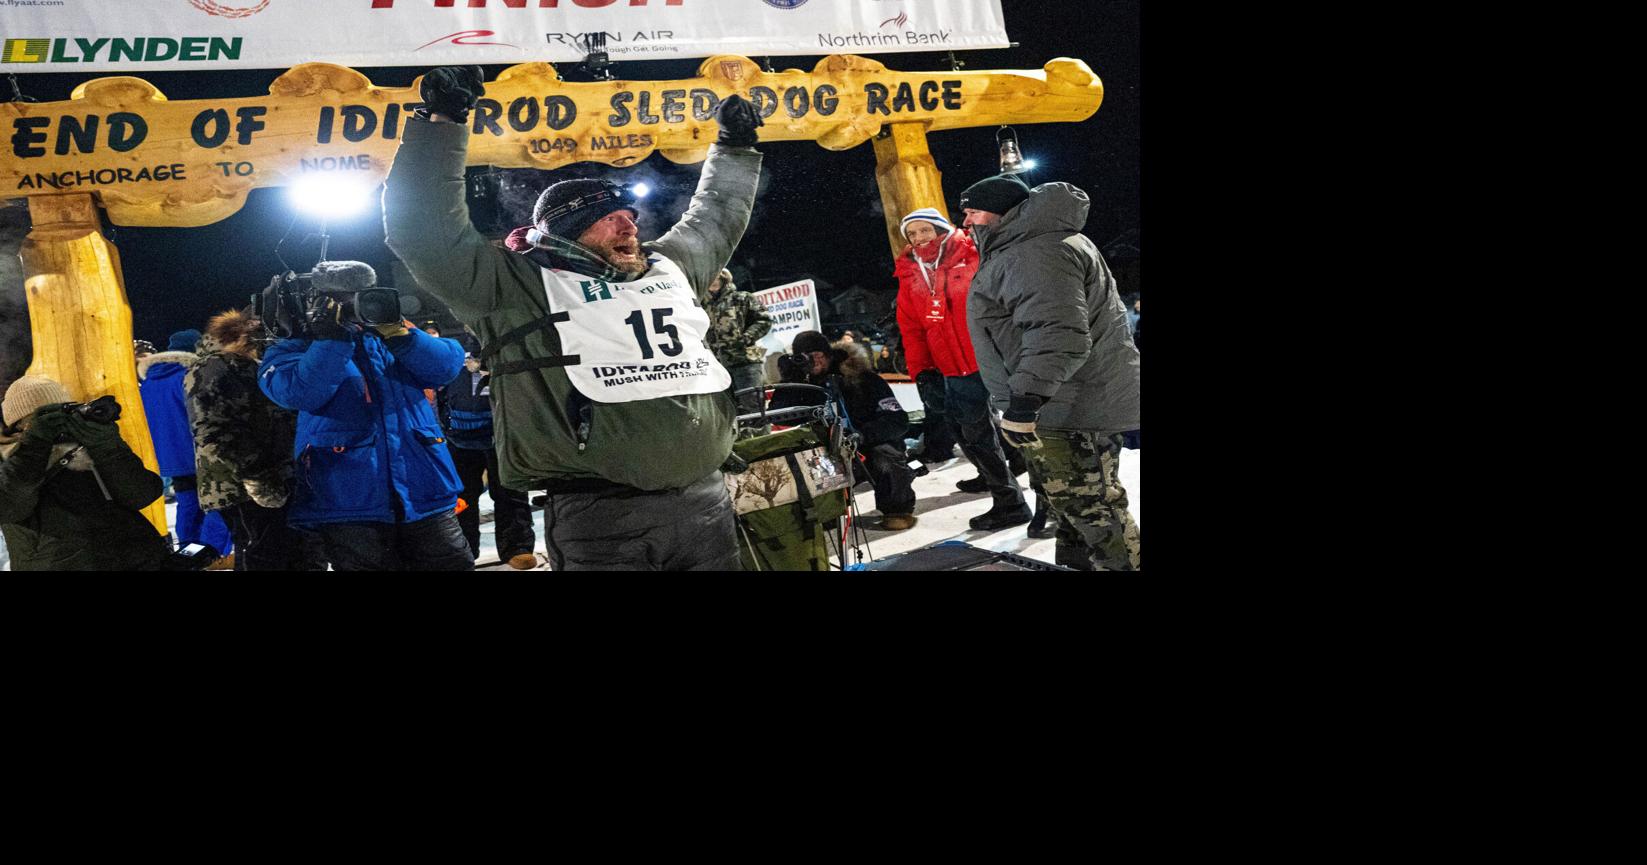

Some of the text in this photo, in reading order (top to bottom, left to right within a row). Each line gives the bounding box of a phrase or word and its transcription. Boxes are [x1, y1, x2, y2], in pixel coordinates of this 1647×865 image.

[546, 30, 674, 44] RYN AIR
[818, 29, 949, 48] Northrim Bank
[50, 37, 243, 63] LYNDEN
[11, 80, 962, 158] END OF IDIROD SLED DOG RACE
[529, 134, 654, 154] 1049 MILES
[17, 154, 371, 189] ANCHORAGE TO NOME
[756, 284, 810, 305] DITAROD
[772, 308, 811, 325] AMPION
[624, 308, 683, 359] 15
[604, 375, 643, 387] MUSH
[646, 371, 678, 381] WITH
